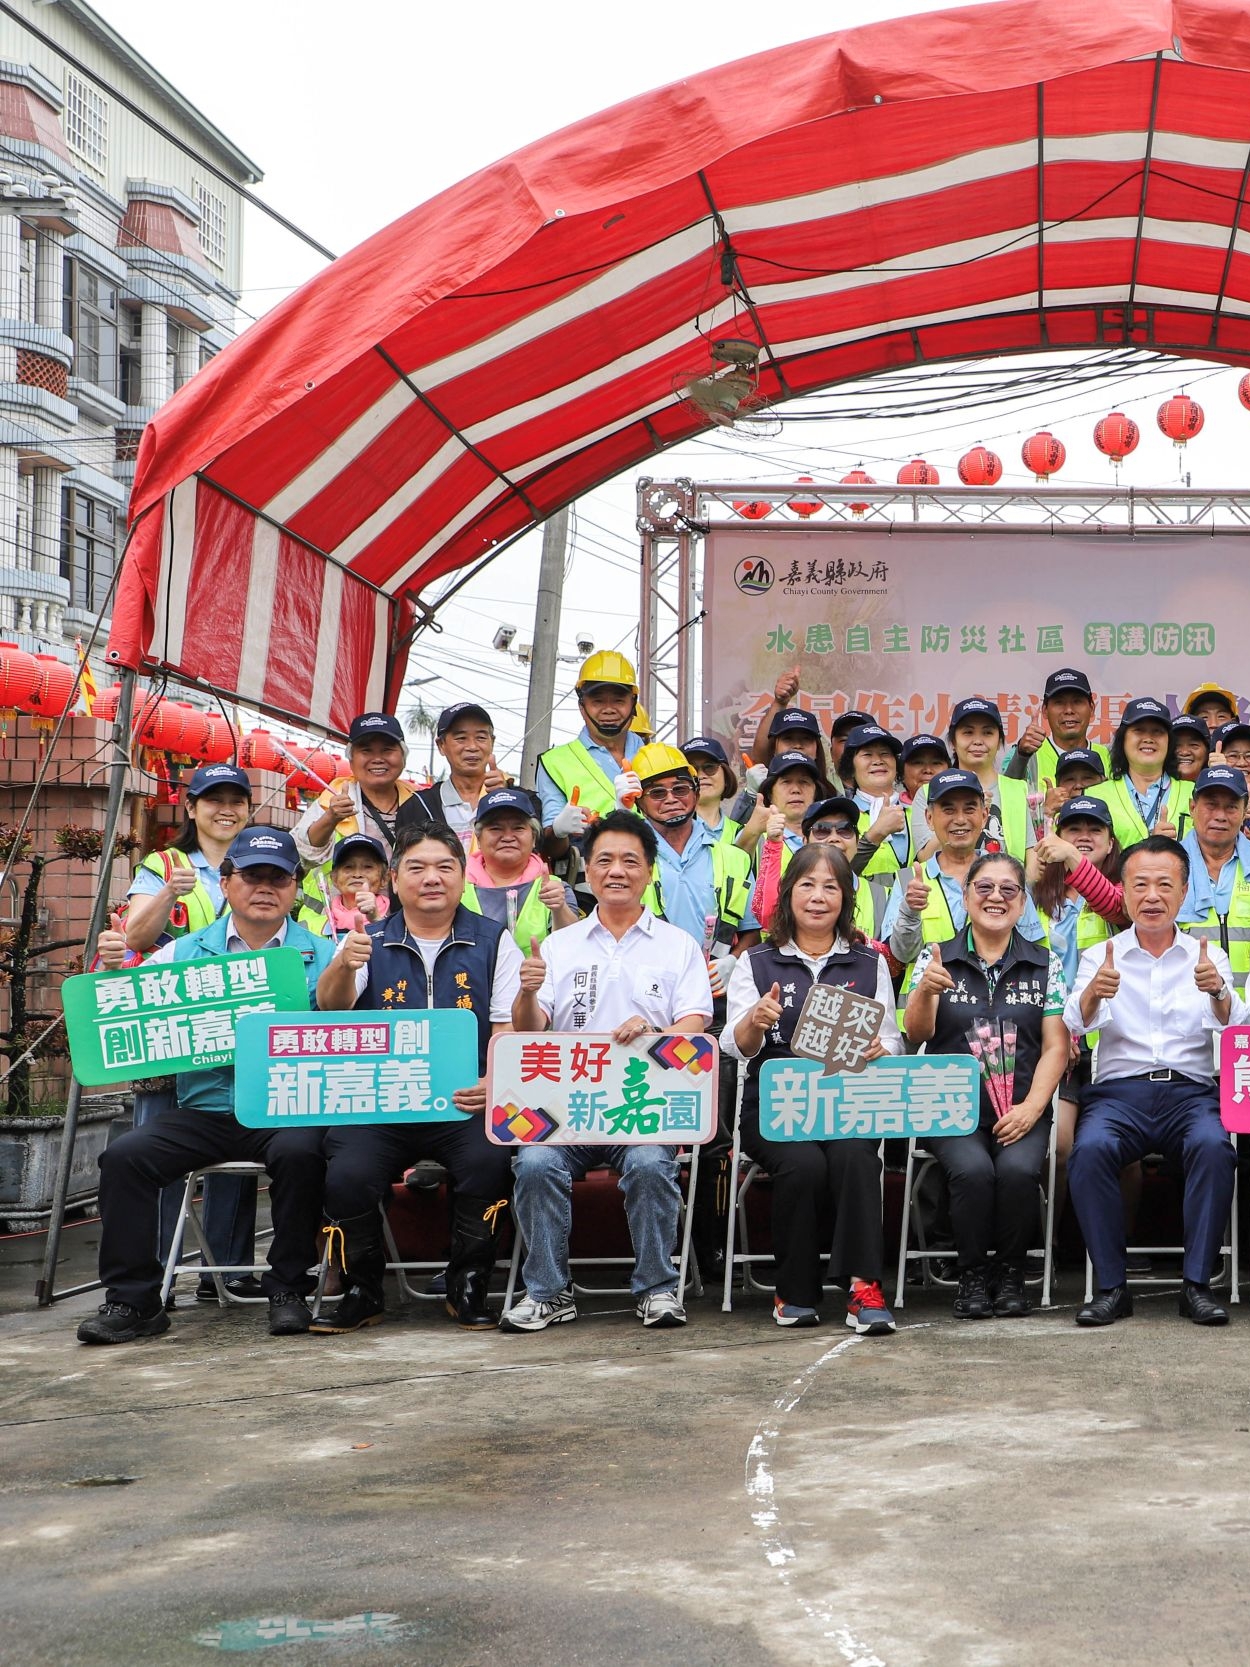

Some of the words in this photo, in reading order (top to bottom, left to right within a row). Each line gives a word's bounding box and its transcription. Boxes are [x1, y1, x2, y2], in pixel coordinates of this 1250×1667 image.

[779, 559, 889, 586] 嘉義縣政府
[783, 587, 808, 596] Chiayi
[811, 587, 838, 596] County
[841, 587, 888, 595] Government
[766, 624, 1065, 654] 水患自主防災社區
[1086, 624, 1214, 654] 清溝防汛
[94, 956, 270, 1014] 勇敢轉型
[381, 988, 395, 1010] 黃
[396, 980, 408, 1003] 村長
[572, 971, 588, 1029] 何文華
[806, 988, 880, 1036] 越來
[273, 1026, 387, 1054] 勇敢轉型
[394, 1020, 430, 1055] 創
[794, 1021, 870, 1068] 越好
[192, 1051, 232, 1065] Chiayi
[520, 1042, 611, 1083] 美好
[568, 1057, 700, 1136] 新嘉園
[770, 1064, 974, 1137] 新嘉義
